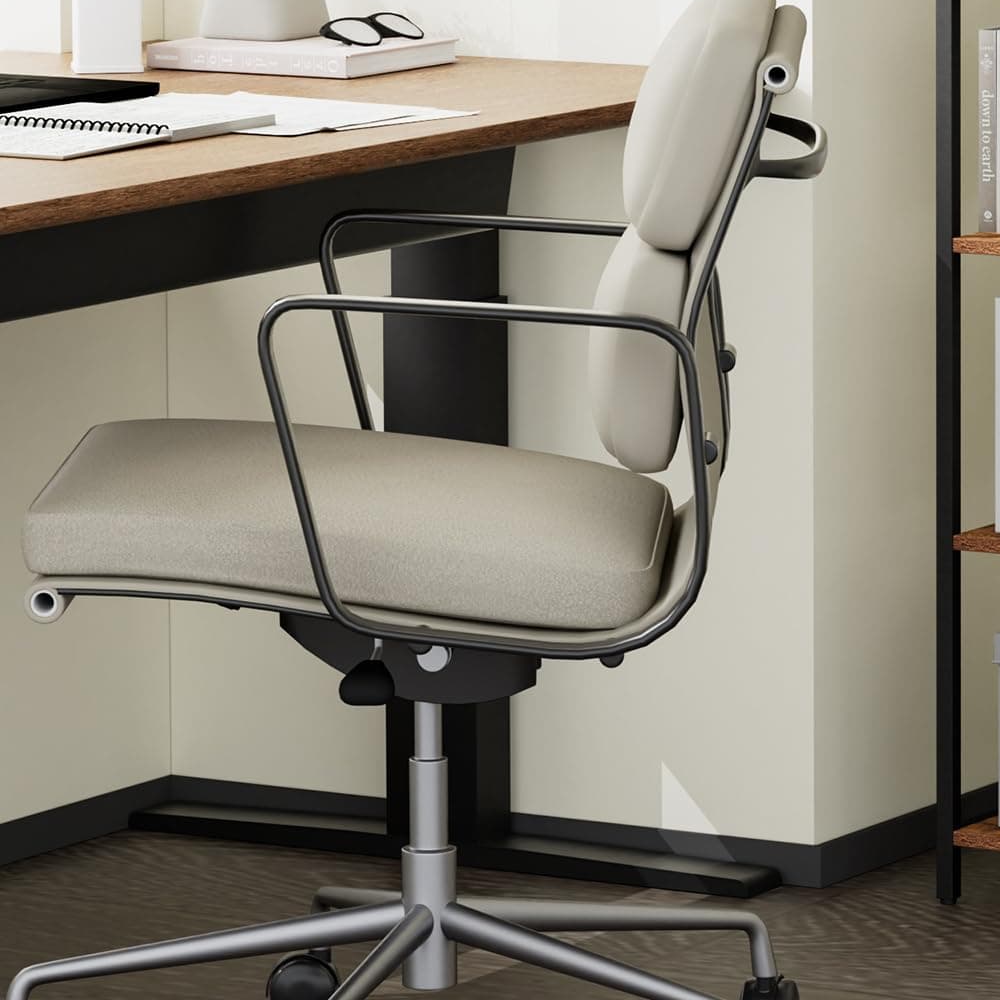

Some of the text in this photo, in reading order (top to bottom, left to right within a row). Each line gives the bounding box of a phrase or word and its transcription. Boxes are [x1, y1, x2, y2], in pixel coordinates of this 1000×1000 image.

[981, 89, 995, 183] down to earth
